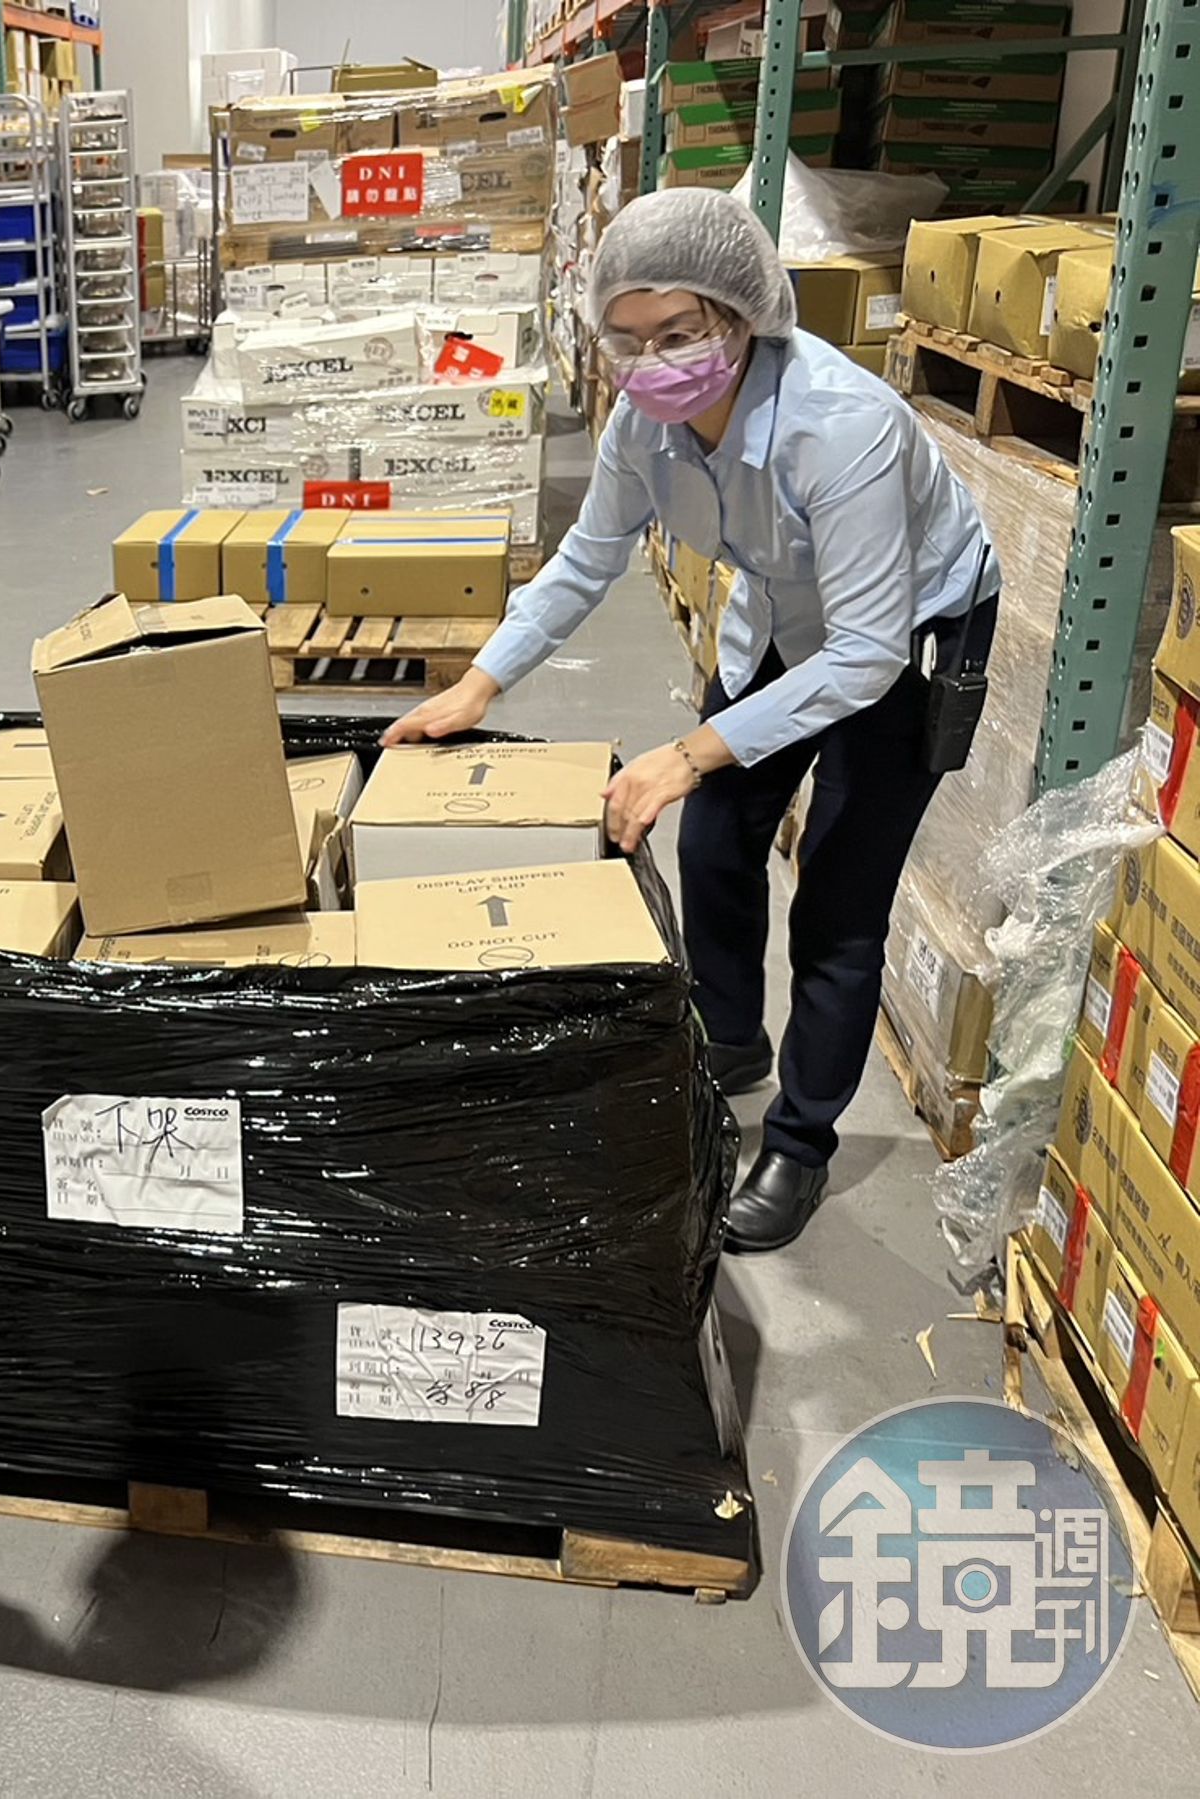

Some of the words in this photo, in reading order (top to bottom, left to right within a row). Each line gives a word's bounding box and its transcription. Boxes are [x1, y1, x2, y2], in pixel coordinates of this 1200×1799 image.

[359, 165, 405, 181] DNI
[460, 171, 512, 193] CEL
[384, 457, 477, 477] EXCEL
[202, 469, 290, 485] EXCEL
[321, 493, 370, 507] DNI
[417, 876, 487, 890] DISPLAY
[491, 870, 565, 883] SHIPPER
[458, 885, 493, 894] LIFT
[498, 882, 526, 890] LID
[448, 940, 474, 949] DO
[480, 935, 517, 947] NOT
[522, 931, 559, 943] CUT
[184, 1107, 229, 1116] COSTCO
[488, 1319, 535, 1329] COSTCO
[410, 1326, 506, 1355] 113926
